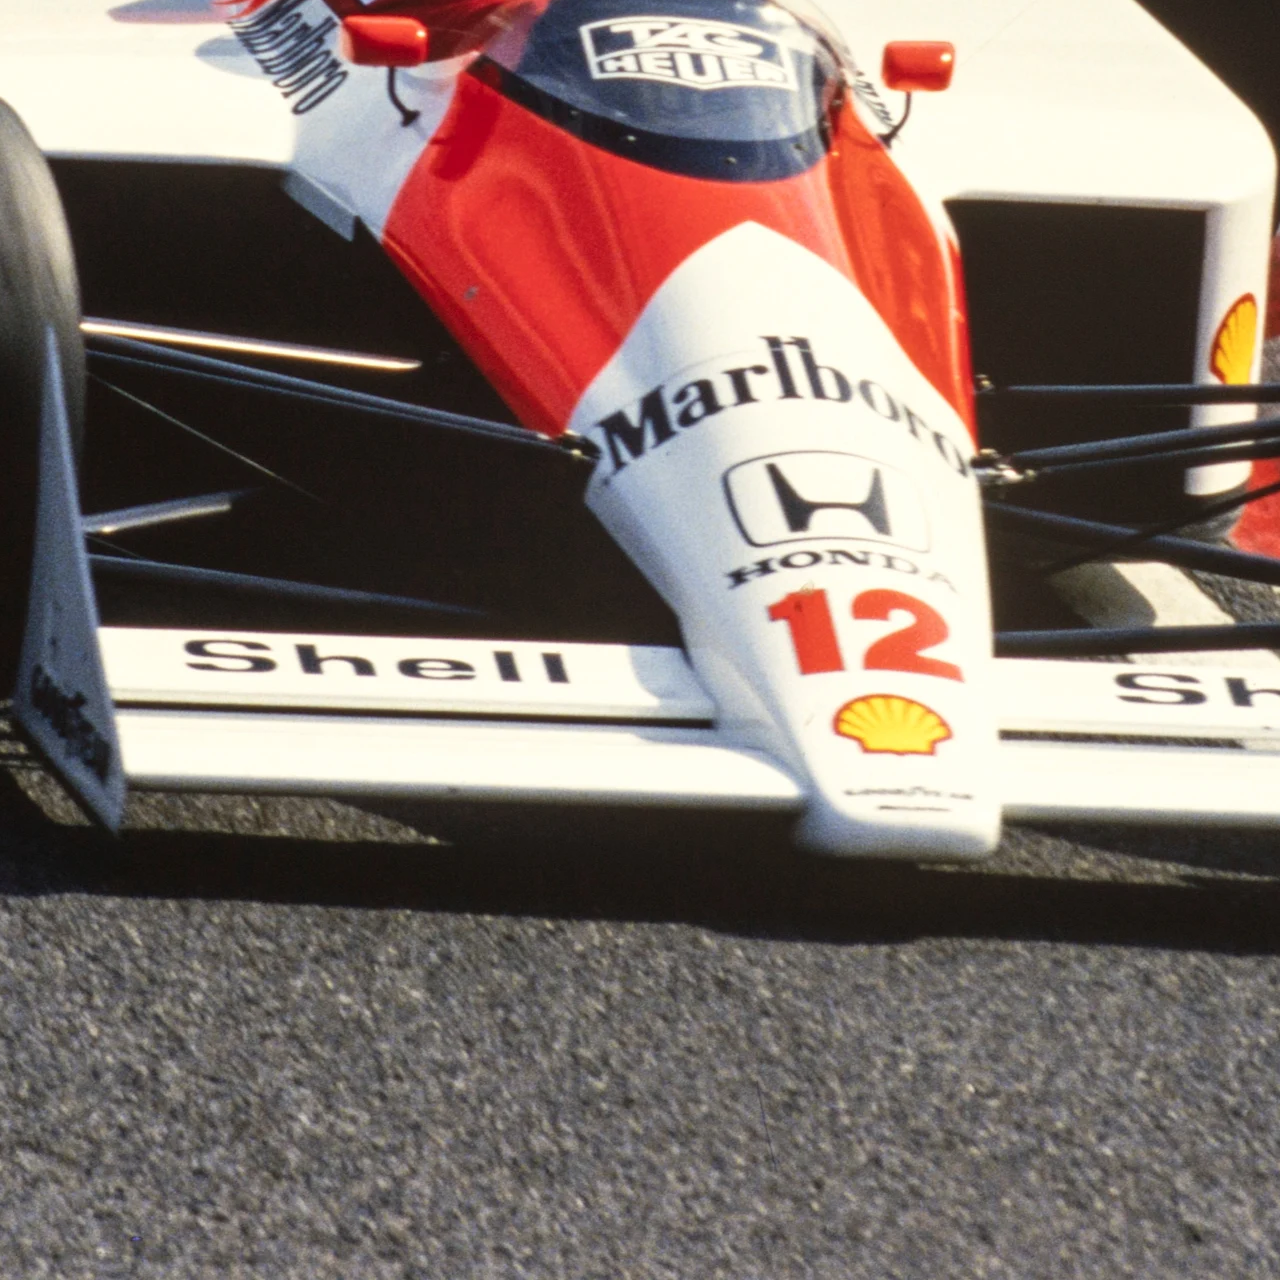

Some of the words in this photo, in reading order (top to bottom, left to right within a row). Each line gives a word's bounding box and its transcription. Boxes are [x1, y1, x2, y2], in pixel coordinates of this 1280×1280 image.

[609, 22, 763, 57] TAG
[598, 52, 789, 84] HEUER
[594, 335, 970, 485] Marlboro
[725, 549, 957, 593] HONDA
[767, 588, 966, 683] 12
[183, 638, 571, 685] Shell
